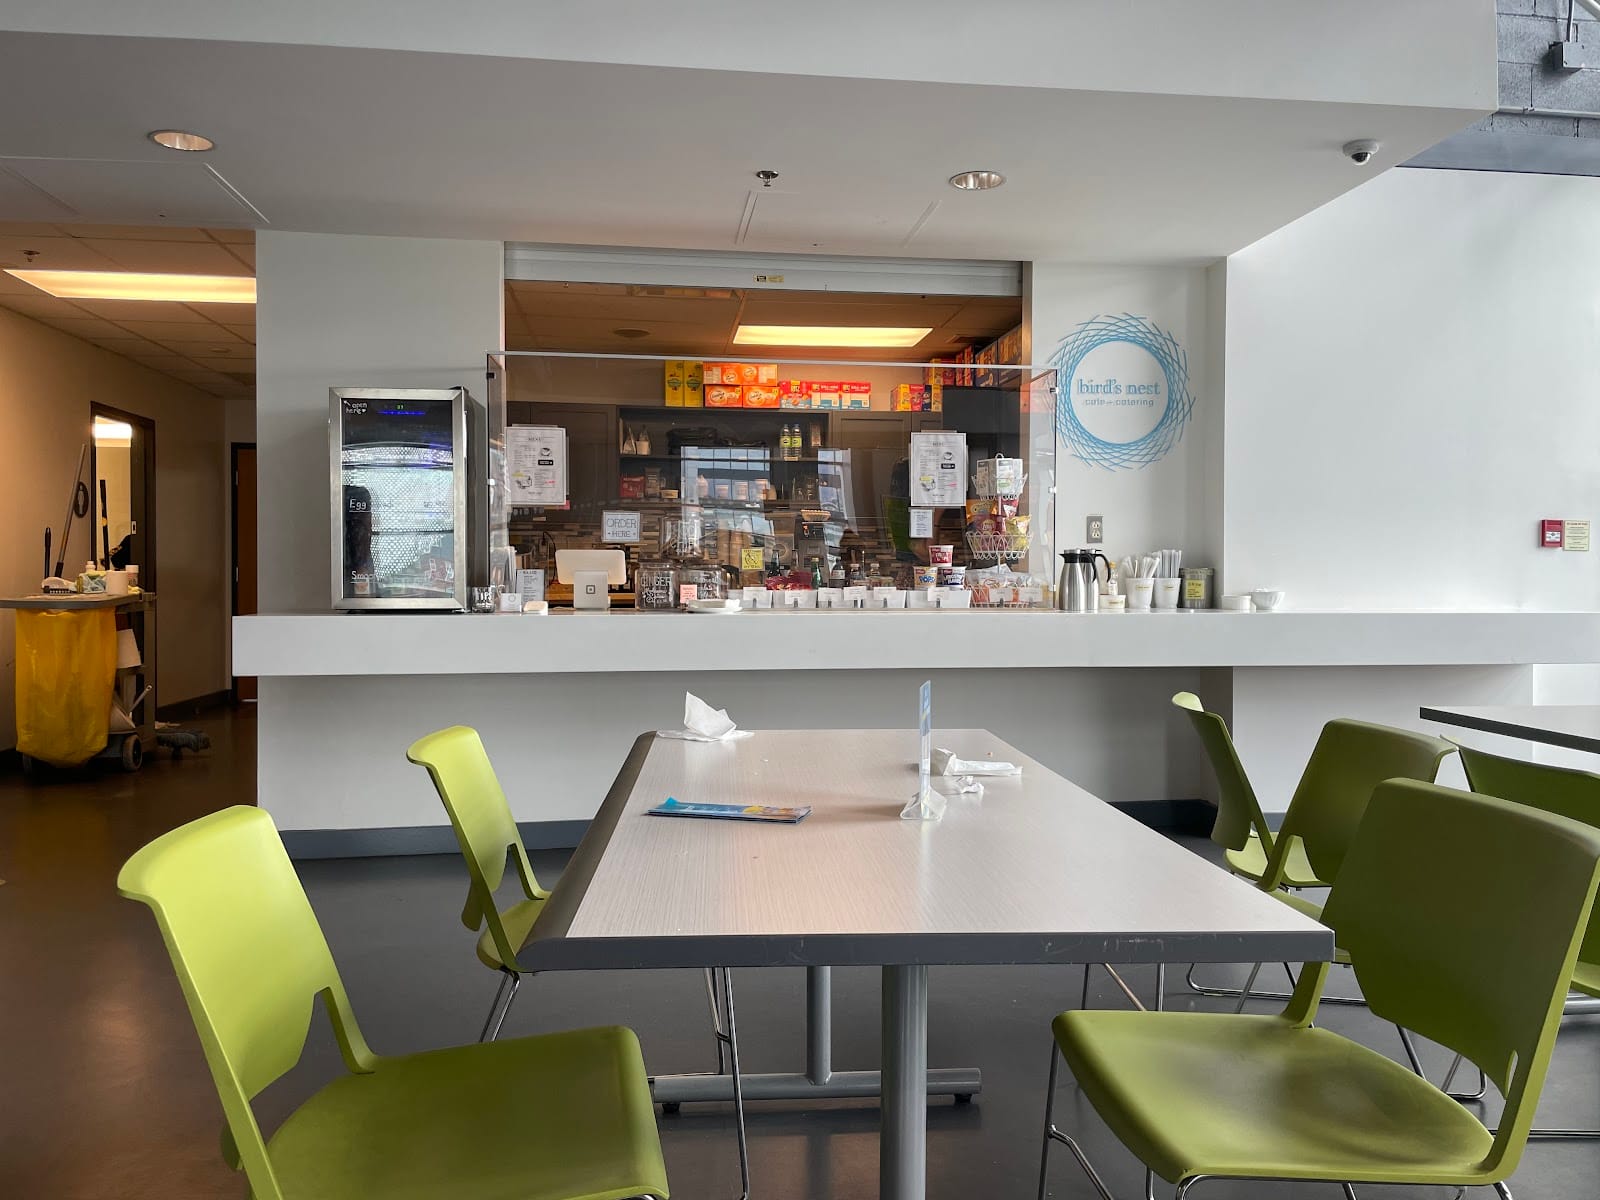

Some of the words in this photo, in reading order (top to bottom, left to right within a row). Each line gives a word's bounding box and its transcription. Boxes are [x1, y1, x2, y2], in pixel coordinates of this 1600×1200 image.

[1078, 379, 1122, 395] bird's
[1126, 382, 1161, 395] nest
[1115, 398, 1154, 407] catering
[349, 499, 367, 511] Egg
[607, 518, 637, 528] ORDER
[612, 530, 631, 538] HERE
